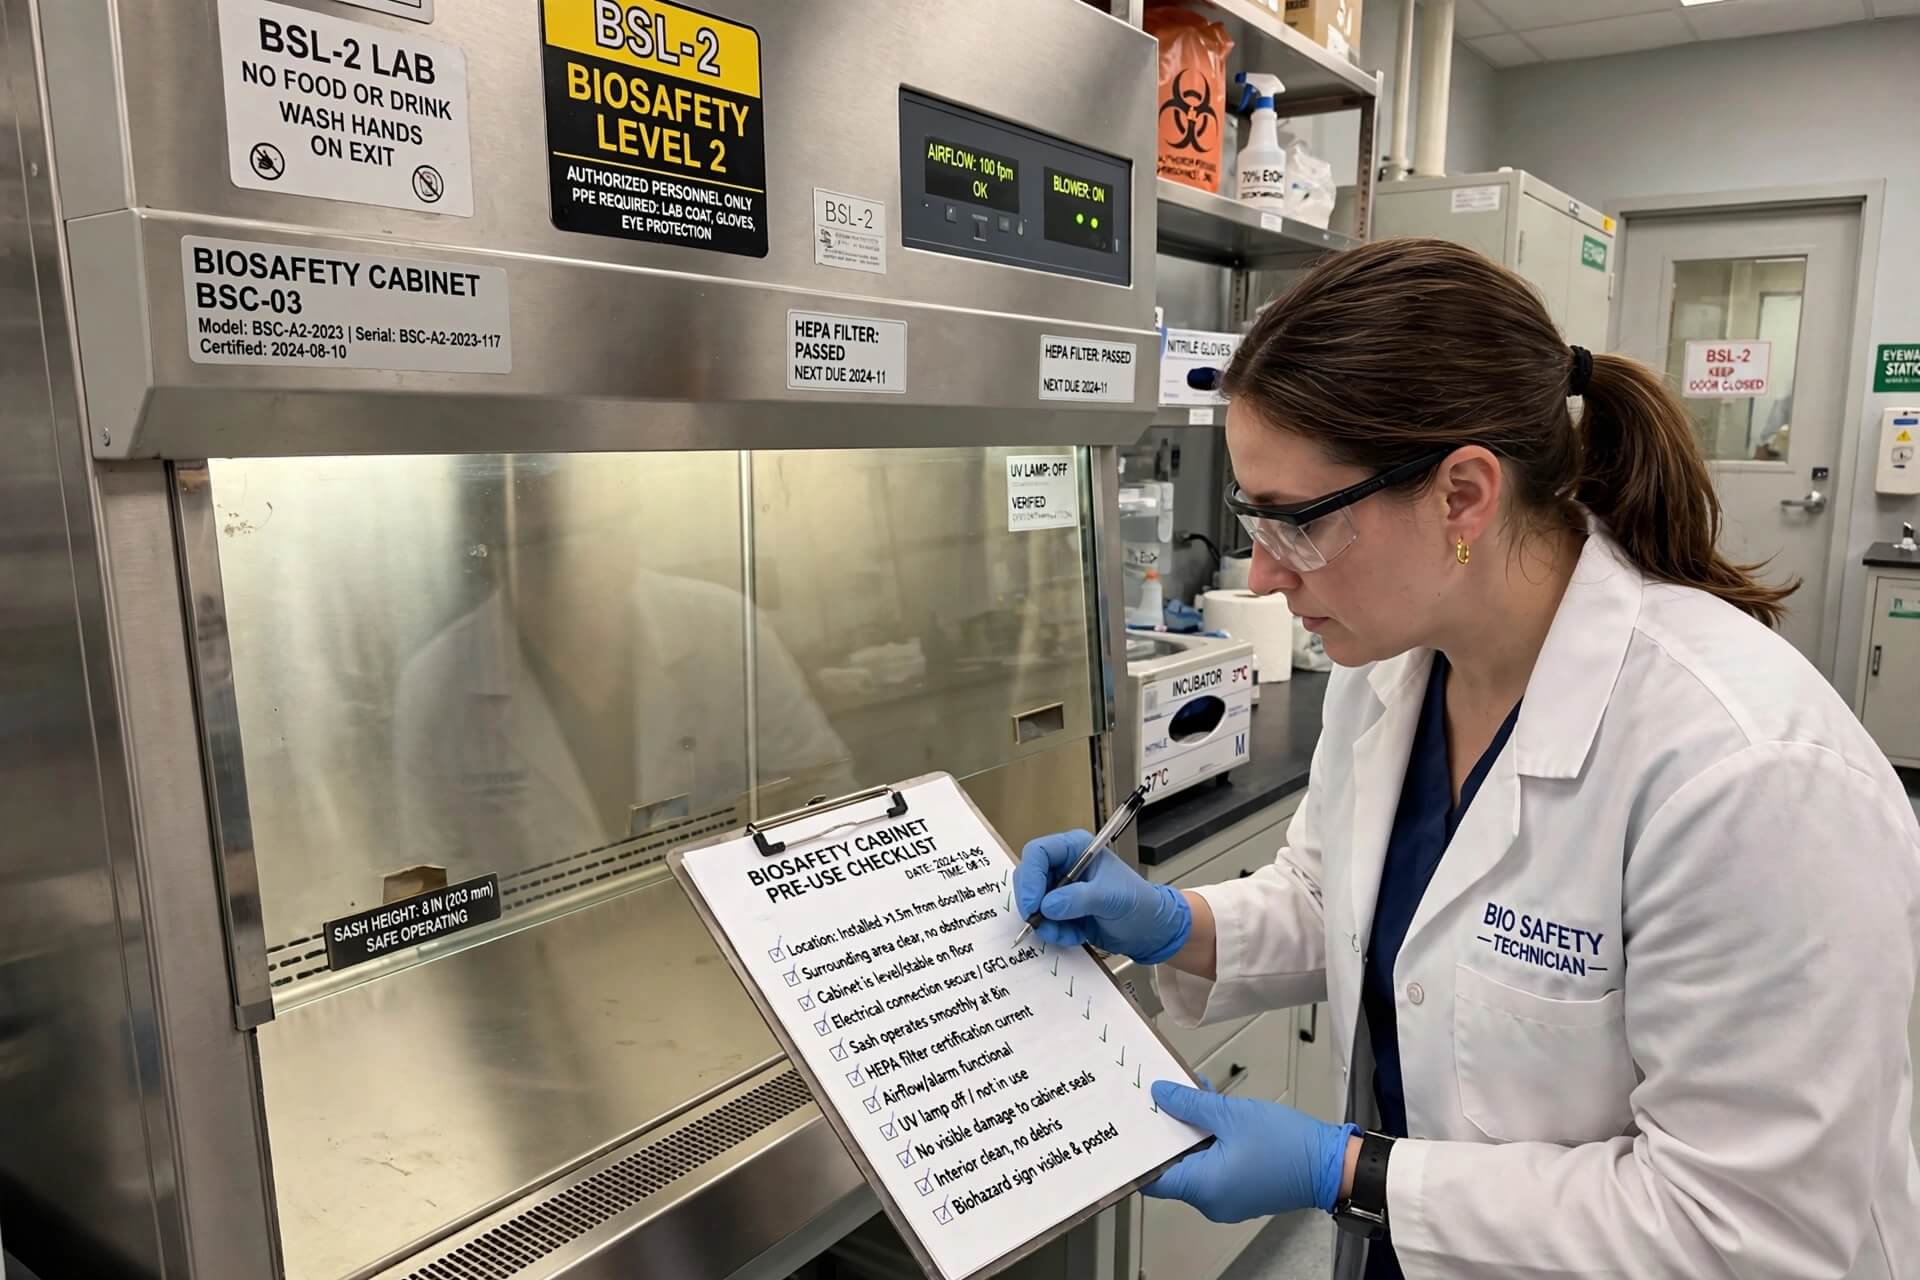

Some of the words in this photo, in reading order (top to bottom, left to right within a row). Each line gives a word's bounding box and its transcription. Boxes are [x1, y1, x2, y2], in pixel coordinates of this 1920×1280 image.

[259, 18, 361, 69] BSL-2
[372, 43, 435, 85] LAB
[594, 0, 721, 77] BSL-2
[242, 60, 276, 87] NO
[284, 69, 347, 100] FOOD
[353, 83, 384, 108] OR
[390, 90, 452, 121] DRINK
[567, 61, 749, 137] BIOSAFETY
[279, 101, 345, 132] WASH
[352, 114, 423, 145] HANDS
[597, 113, 701, 169] LEVEL
[709, 139, 727, 173] 2
[311, 135, 343, 159] ON
[350, 141, 395, 167] EXIT
[927, 143, 977, 172] AIRFLOW:
[980, 157, 995, 175] 100
[997, 161, 1014, 181] fpm
[567, 165, 649, 193] AUTHORIZED
[652, 180, 722, 206] PERSONNEL
[724, 193, 753, 211] ONLY
[972, 180, 988, 199] OK
[1053, 175, 1090, 199] BLOWER:
[1092, 187, 1105, 203] ON
[1242, 170, 1261, 183] 70%
[572, 187, 596, 205] PPE
[599, 191, 660, 215] REQUIRED:
[662, 203, 683, 217] LAB
[685, 207, 714, 225] COAT,
[716, 211, 756, 232] GLOVES,
[622, 215, 644, 231] EYE
[646, 219, 712, 240] PROTECTION
[825, 200, 873, 229] BSL-2
[193, 247, 360, 287] BIOSAFETY
[368, 264, 480, 297] CABINET
[196, 282, 302, 315] BSC-03
[198, 317, 248, 336] Model:
[252, 321, 344, 340] BSC-A2-2023
[356, 327, 396, 343] Serial:
[399, 329, 501, 349] BSC-A2-2023-117
[200, 339, 268, 357] Certified:
[271, 342, 347, 359] 2024-08-10
[795, 319, 831, 339] HEPA
[834, 324, 880, 344] FILTER:
[795, 342, 845, 361] PASSED
[1168, 339, 1198, 354] NITRILE
[1201, 342, 1231, 356] GLOVES
[795, 365, 823, 381] NEXT
[825, 366, 846, 382] DUE
[849, 368, 886, 385] 2024-11
[1045, 344, 1068, 359] HEPA
[1070, 347, 1099, 363] FILTER:
[1101, 349, 1131, 364] PASSED
[1706, 349, 1751, 363] BSL-2
[1043, 378, 1063, 392] NEXT
[1065, 379, 1080, 393] DUE
[1082, 380, 1108, 394] 2024-11
[1722, 380, 1764, 390] CLOSED
[1011, 464, 1023, 477] UV
[1024, 463, 1050, 477] LAMP:
[1052, 463, 1067, 476] OFF
[1012, 496, 1046, 509] VERIFIED
[1173, 669, 1222, 697] INCUBATOR
[1235, 733, 1245, 756] M
[747, 841, 851, 887] BIOSAFETY
[854, 819, 929, 853] CABINET
[766, 867, 846, 904] PRE-USE
[849, 837, 938, 877] CHECKLIST
[904, 864, 935, 880] DATE:
[938, 867, 964, 881] TIME:
[334, 922, 369, 942] SASH
[371, 904, 419, 932] HEIGHT:
[422, 902, 428, 915] 8
[430, 897, 442, 912] IN
[445, 889, 468, 911] (203
[471, 881, 493, 901] mm)
[366, 931, 399, 953] SAFE
[400, 909, 468, 942] OPERATING
[786, 932, 838, 957] Location:
[837, 914, 883, 940] Installed
[882, 908, 914, 928] >1.5m
[913, 900, 937, 916] from
[939, 887, 976, 906] door/lab
[977, 881, 1001, 899] entry
[1484, 902, 1515, 932] BIO
[1520, 915, 1604, 956] SAFETY
[802, 948, 872, 980] Surrounding
[872, 941, 895, 958] area
[896, 930, 925, 949] clear,
[925, 925, 938, 938] no
[939, 907, 998, 933] obstructions
[1494, 933, 1586, 977] TECHNICIAN
[817, 980, 863, 1006] Cabinet
[863, 975, 874, 989] is
[875, 952, 936, 983] level/stable
[936, 950, 950, 962] on
[949, 940, 975, 958] floor
[831, 1000, 885, 1030] Electrical
[886, 982, 944, 1010] connection
[943, 971, 978, 989] secure
[977, 966, 983, 979] /
[982, 958, 1009, 975] GFCI
[1009, 946, 1039, 965] outlet
[849, 1033, 880, 1054] Sash
[880, 1016, 929, 1044] operates
[929, 997, 980, 1025] smoothly
[980, 992, 992, 1006] at
[991, 985, 1011, 1001] 8in
[865, 1057, 901, 1080] HEPA
[898, 1045, 929, 1066] filter
[930, 1022, 995, 1055] certification
[994, 1005, 1034, 1029] current
[882, 1065, 960, 1105] Airflow/alarm
[958, 1041, 1014, 1074] functional
[897, 1112, 919, 1132] UV
[918, 1103, 950, 1124] lamp
[951, 1090, 967, 1110] off
[968, 1088, 975, 1105] /
[976, 1083, 998, 1100] not
[995, 1077, 1009, 1092] in
[1009, 1069, 1029, 1084] use
[914, 1143, 936, 1160] No
[935, 1125, 973, 1148] visible
[973, 1107, 1017, 1134] damage
[1015, 1099, 1030, 1114] to
[1030, 1084, 1070, 1109] cabinet
[1069, 1070, 1096, 1089] seals
[934, 1158, 979, 1187] Interior
[980, 1143, 1014, 1165] clean,
[1013, 1134, 1029, 1149] no
[1030, 1118, 1064, 1141] debris
[952, 1174, 1013, 1215] Biohazard
[1012, 1165, 1038, 1186] sign
[1037, 1146, 1072, 1172] visible
[1069, 1142, 1082, 1156] &
[1082, 1122, 1119, 1155] posted
